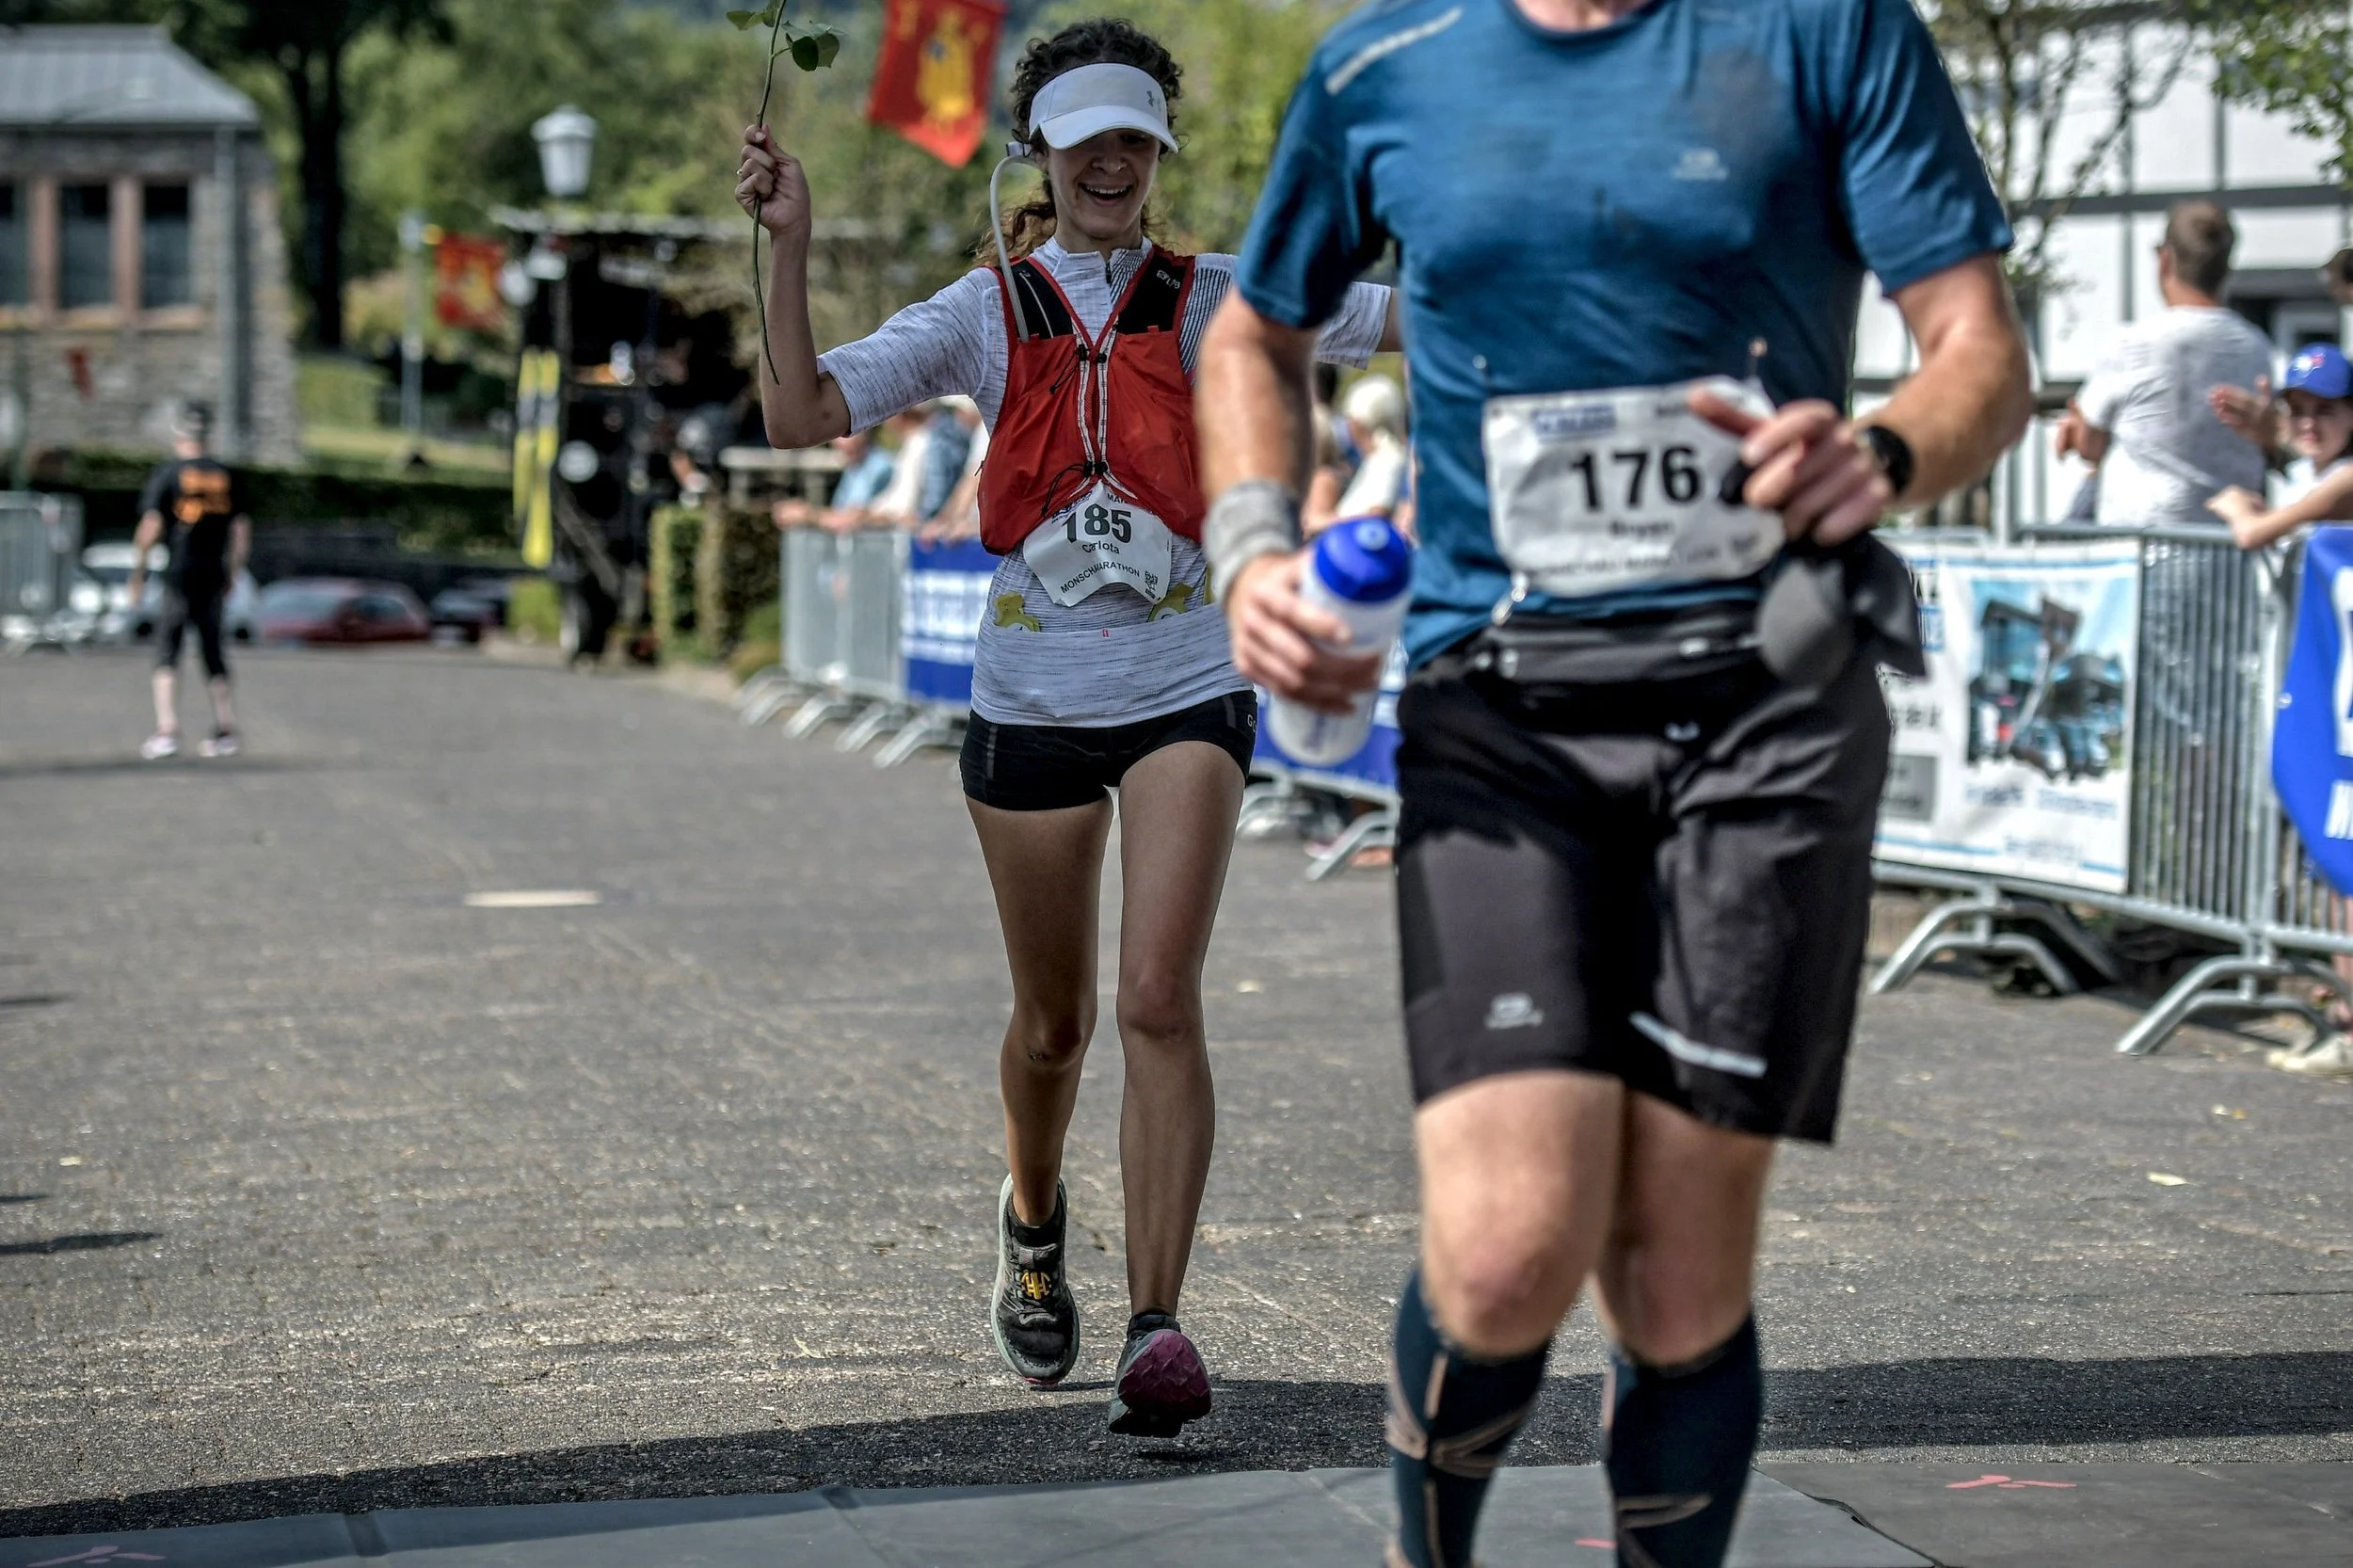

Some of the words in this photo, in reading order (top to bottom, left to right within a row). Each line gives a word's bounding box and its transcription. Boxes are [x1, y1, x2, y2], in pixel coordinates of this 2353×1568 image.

[1572, 445, 1702, 513] 176
[1062, 503, 1131, 543] 185
[1082, 540, 1120, 554] Carlota
